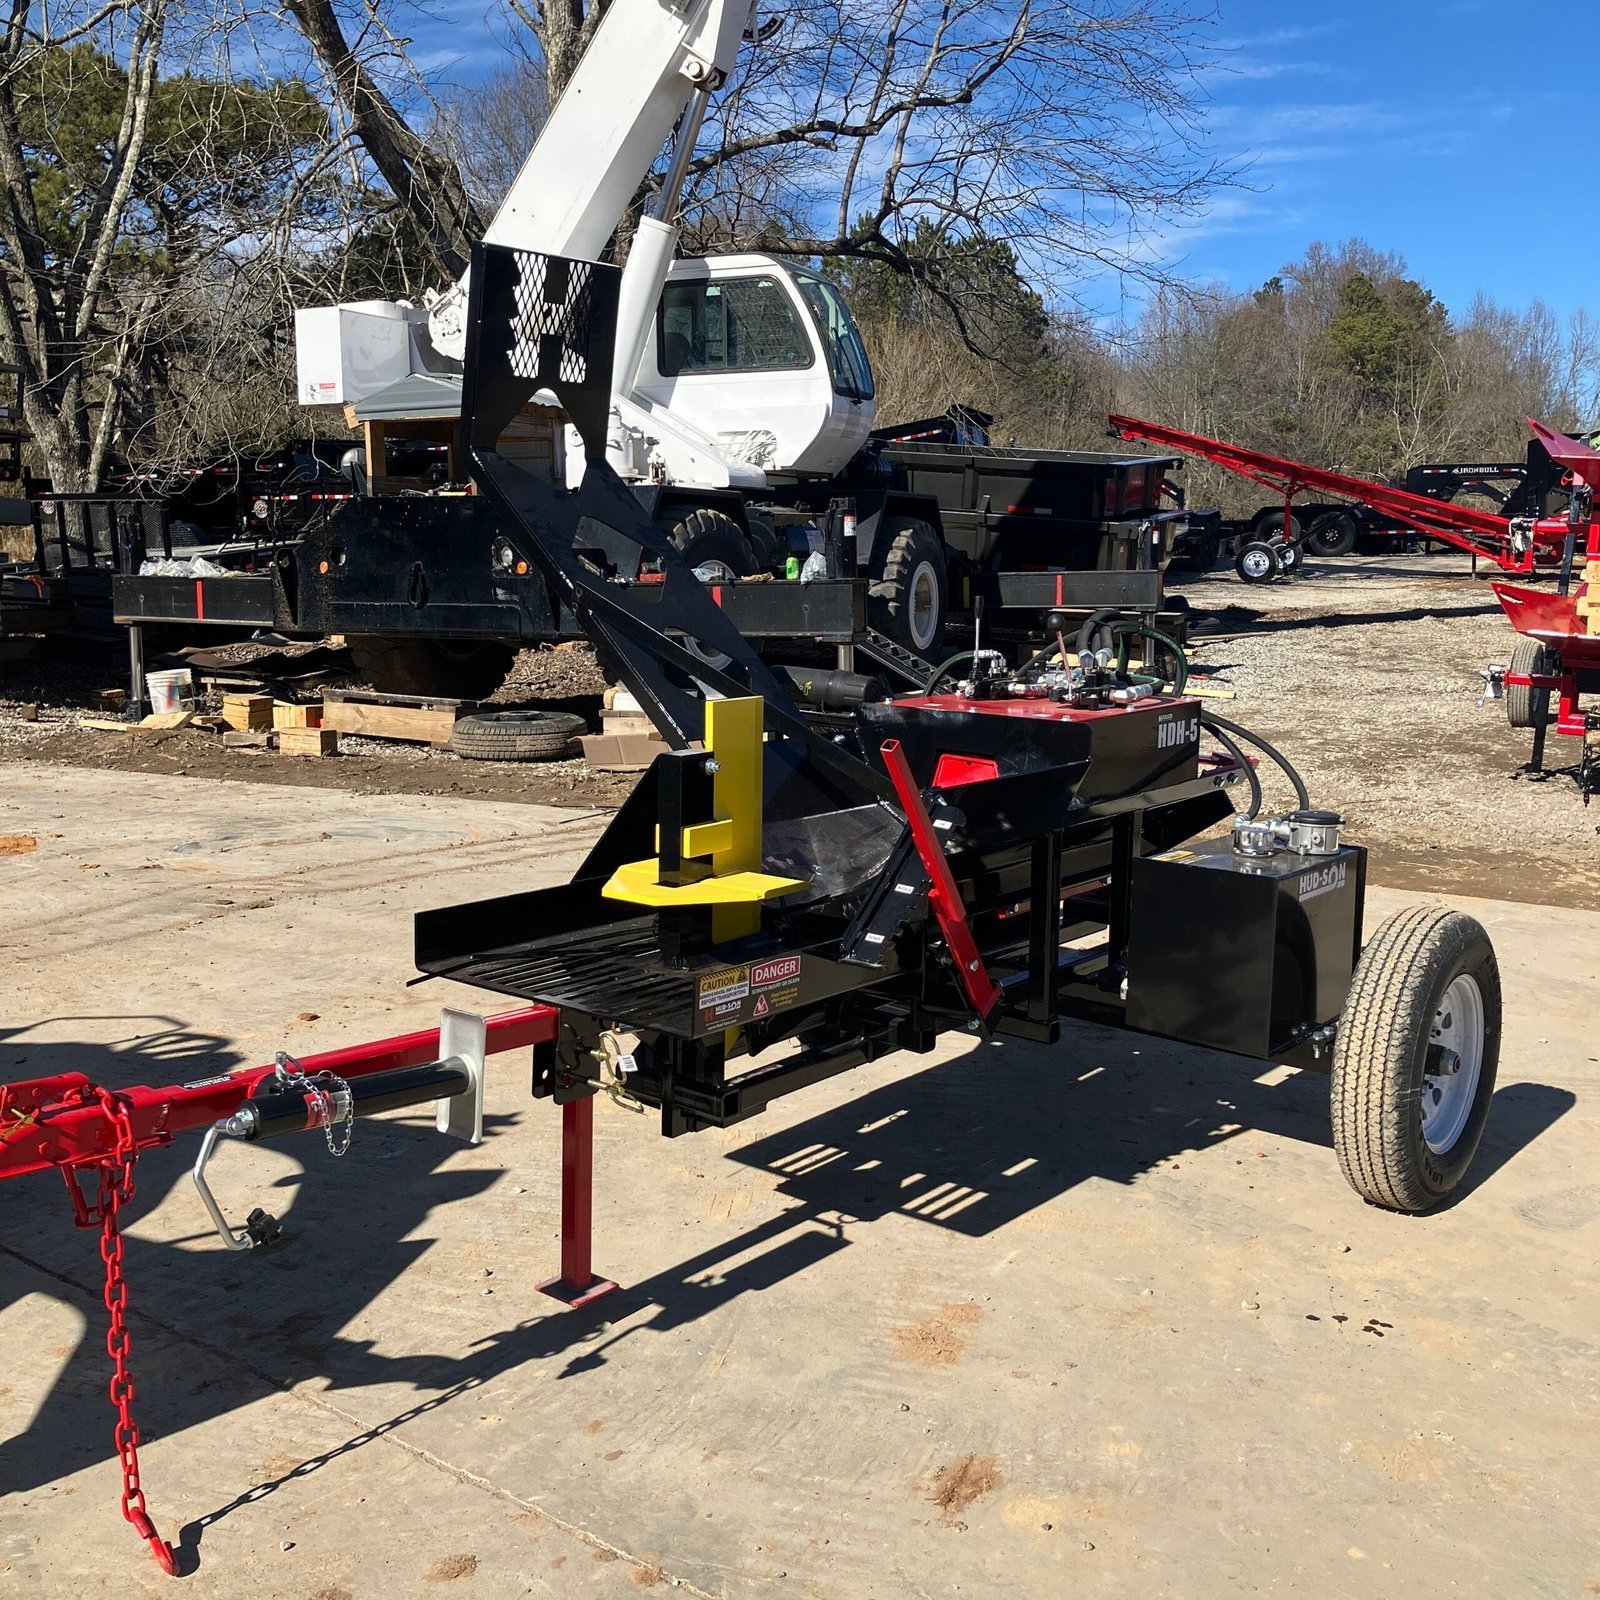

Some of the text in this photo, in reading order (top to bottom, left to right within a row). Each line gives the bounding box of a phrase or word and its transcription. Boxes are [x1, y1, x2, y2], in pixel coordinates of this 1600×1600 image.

[1157, 717, 1198, 749] HDH-5
[1299, 862, 1346, 894] HUD-SON
[701, 975, 735, 992] CAUTION
[755, 960, 796, 982] DANGER
